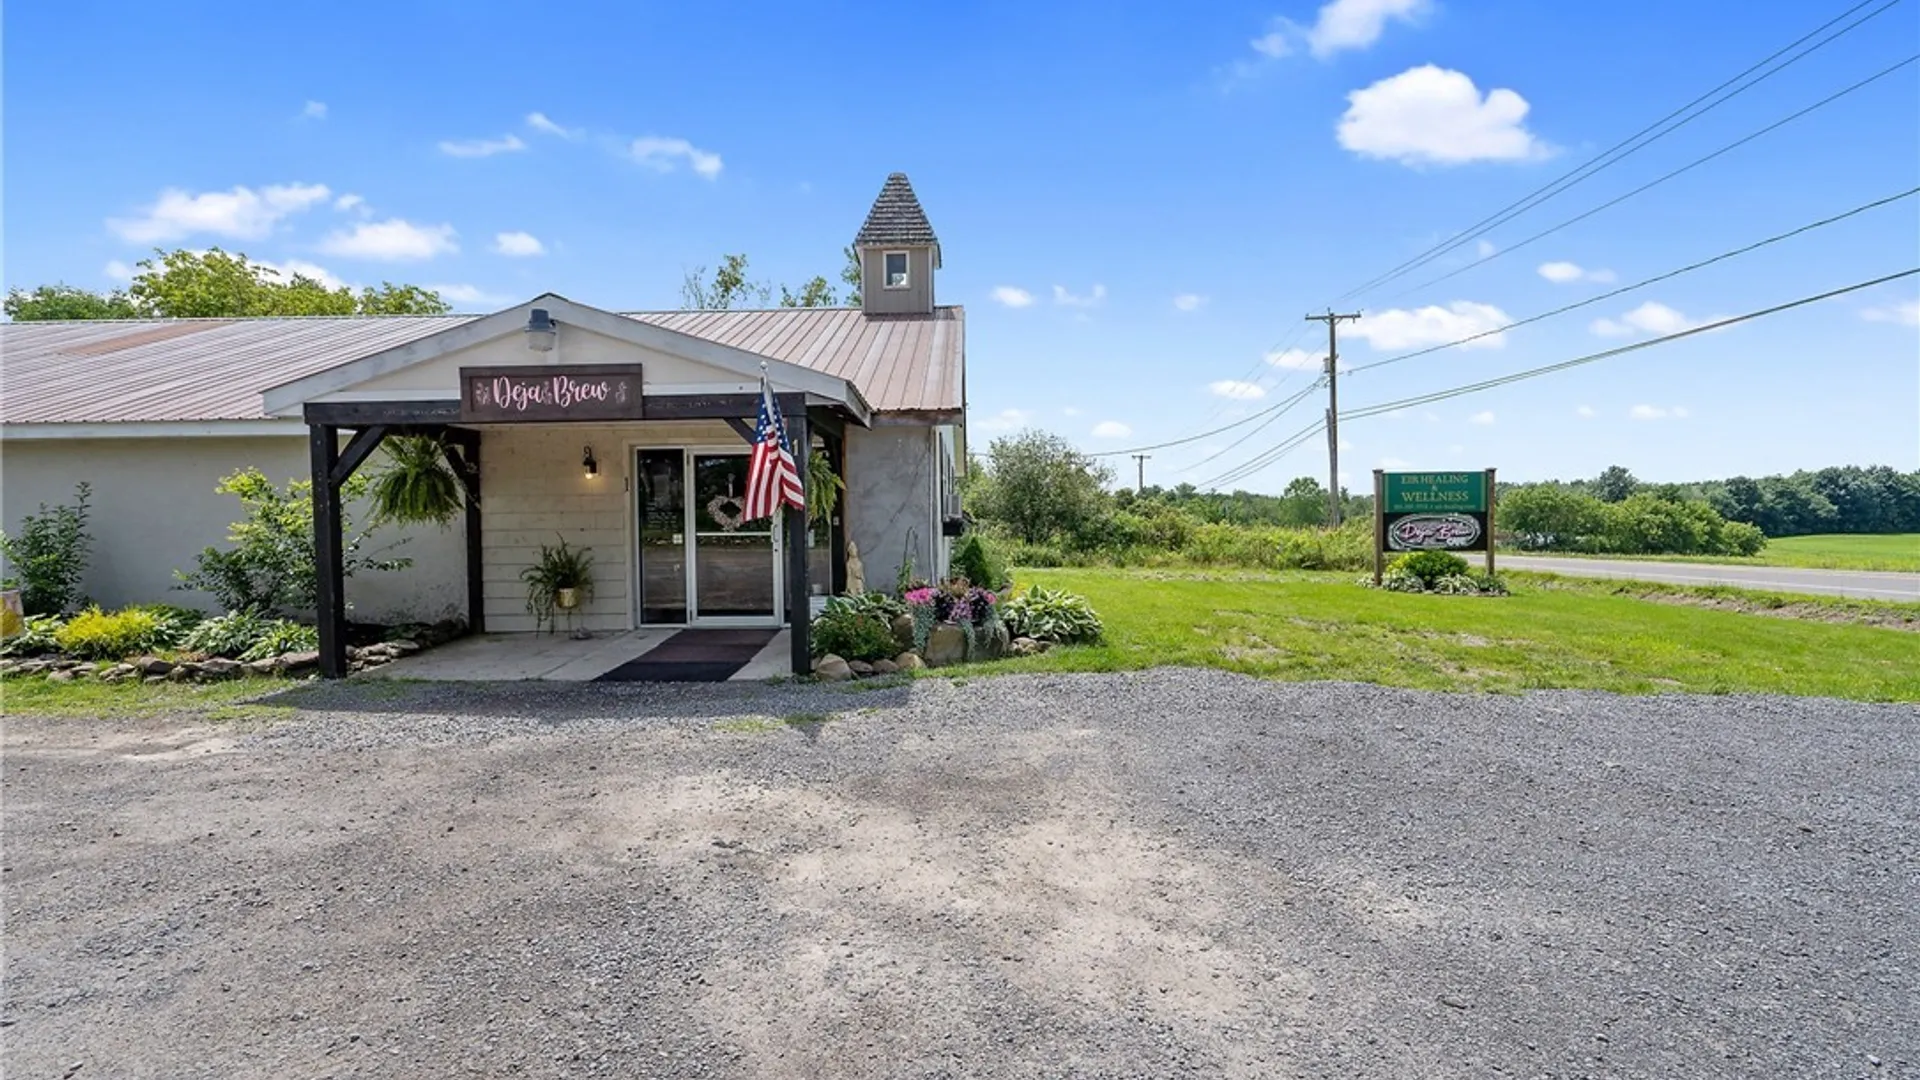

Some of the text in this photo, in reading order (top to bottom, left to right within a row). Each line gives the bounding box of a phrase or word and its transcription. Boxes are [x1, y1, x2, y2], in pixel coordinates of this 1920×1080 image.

[492, 375, 611, 410] Deja Brew
[1420, 474, 1469, 485] HEALING
[1401, 491, 1469, 502] WELLNESS
